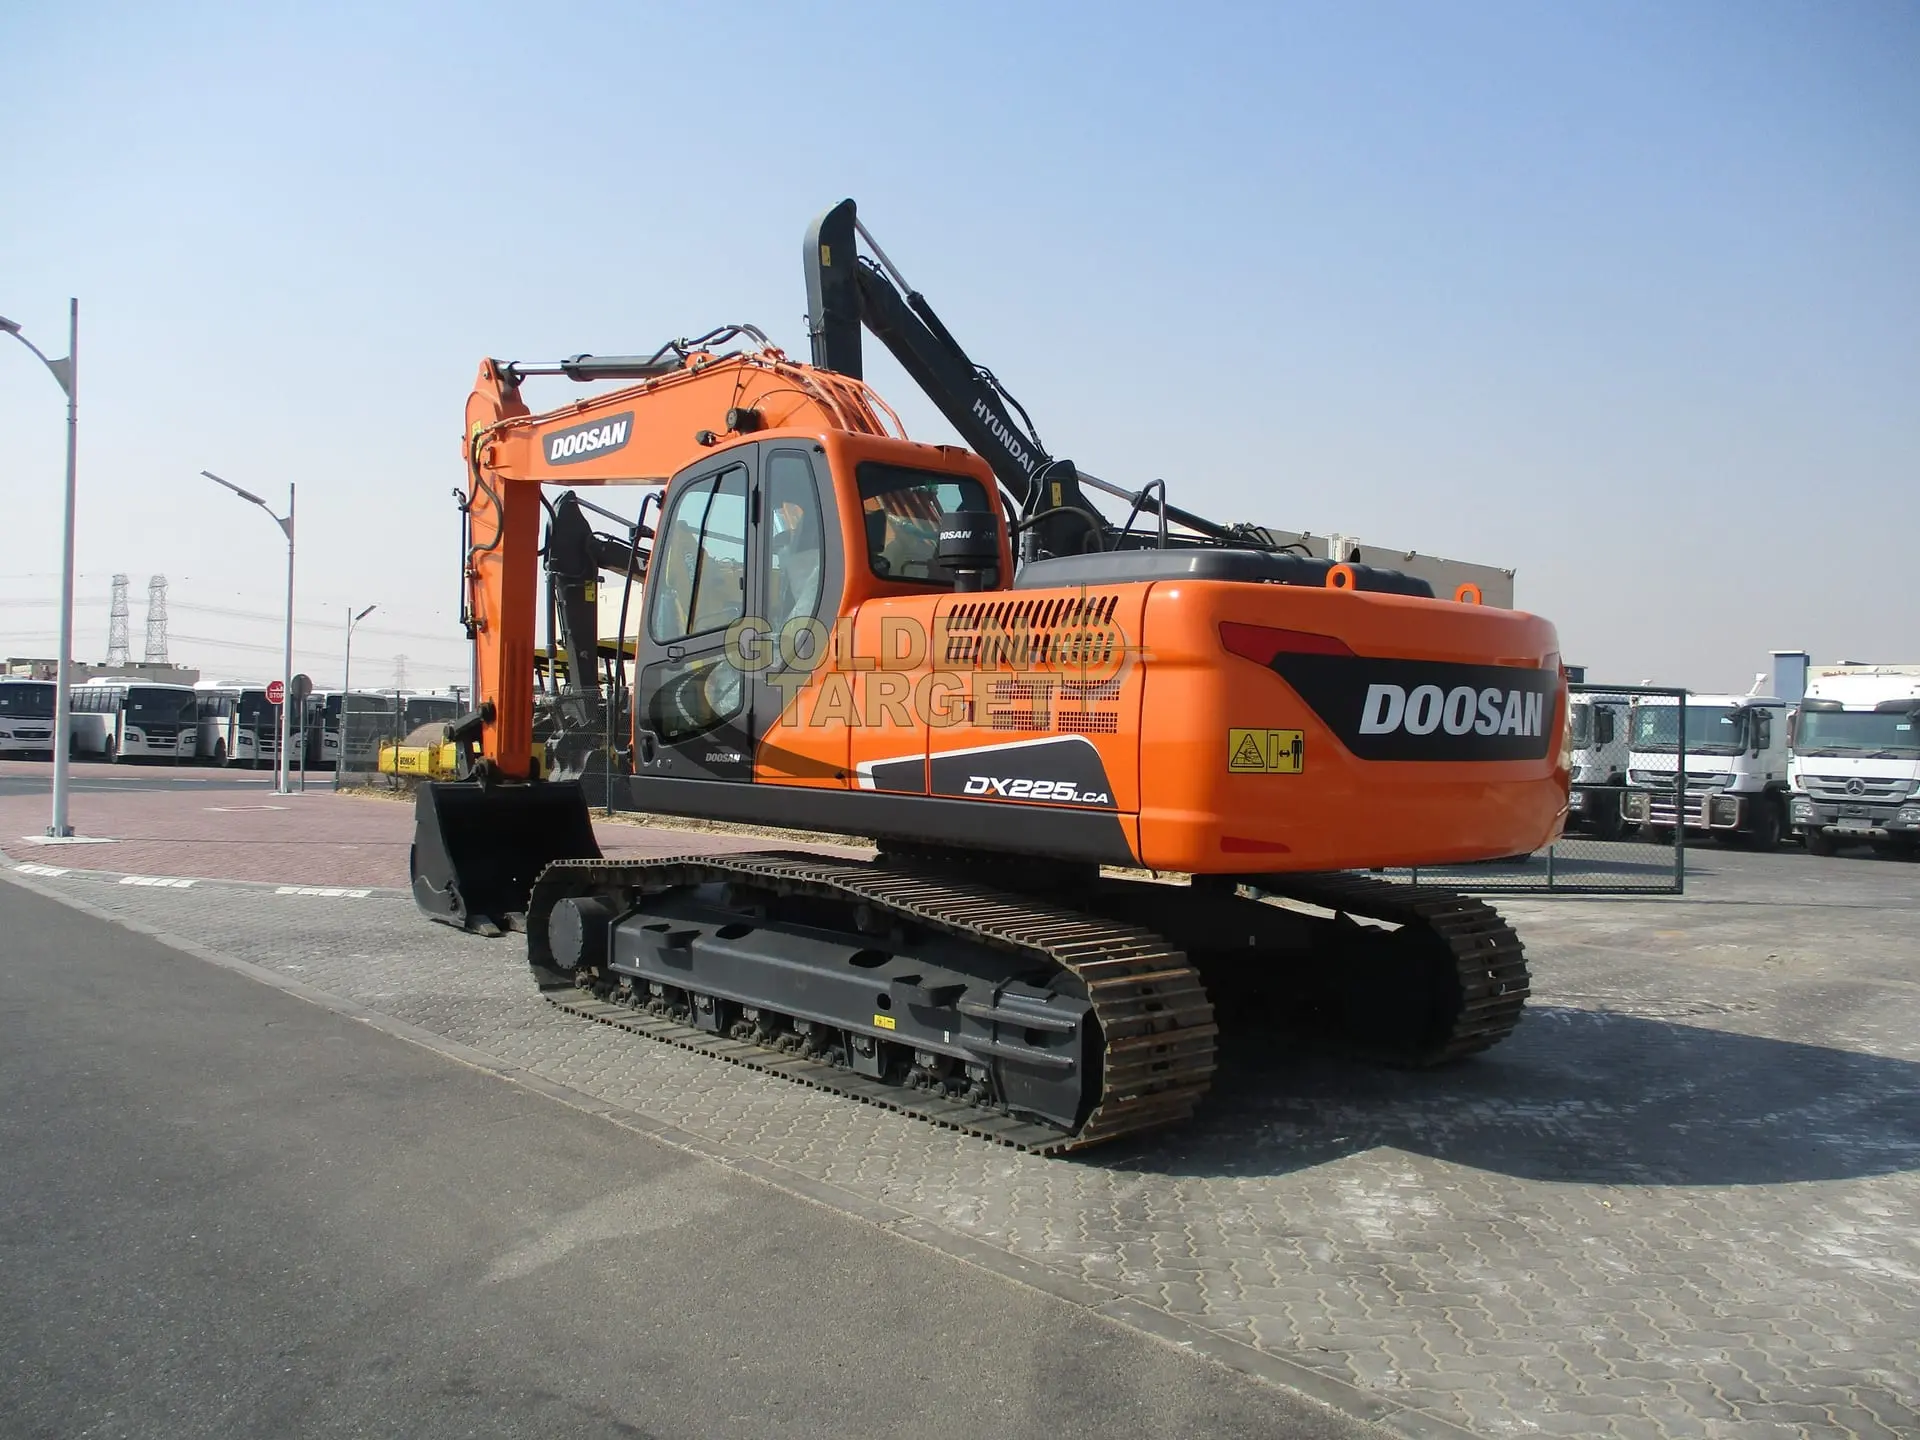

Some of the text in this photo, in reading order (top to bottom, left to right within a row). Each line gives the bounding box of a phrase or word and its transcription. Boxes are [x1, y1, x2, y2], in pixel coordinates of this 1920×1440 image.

[551, 421, 627, 460] DOOSAN
[973, 398, 1035, 473] HYUNDAI
[1358, 684, 1543, 736] DOOSAN
[705, 753, 741, 763] DOOSAN
